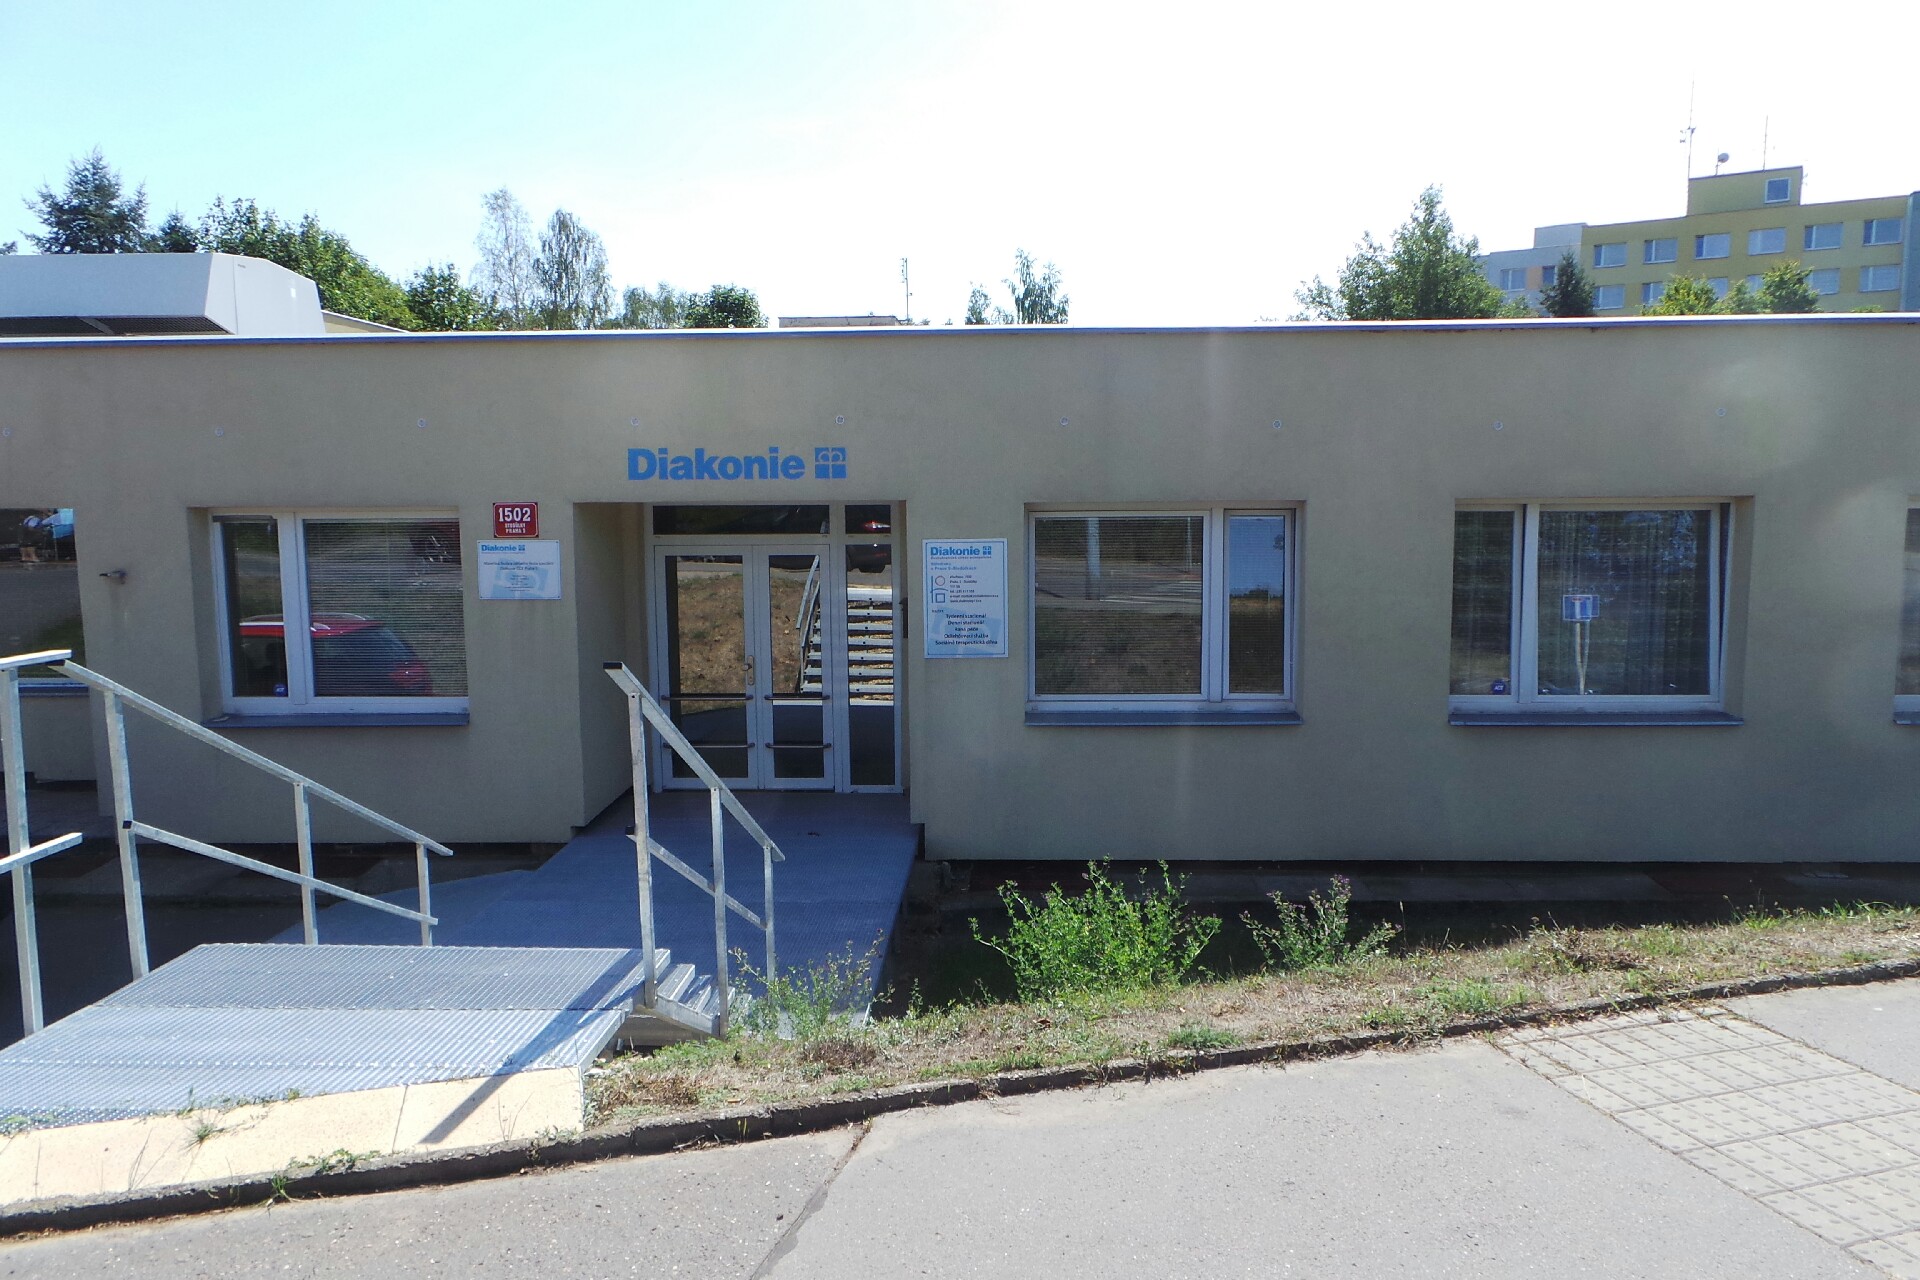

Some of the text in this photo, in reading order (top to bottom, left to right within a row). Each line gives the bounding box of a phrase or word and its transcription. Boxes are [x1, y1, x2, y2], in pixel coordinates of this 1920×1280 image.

[627, 446, 806, 481] Diakonie
[498, 507, 531, 522] 1502
[481, 544, 517, 552] Diakonie
[930, 546, 980, 556] Diakonie
